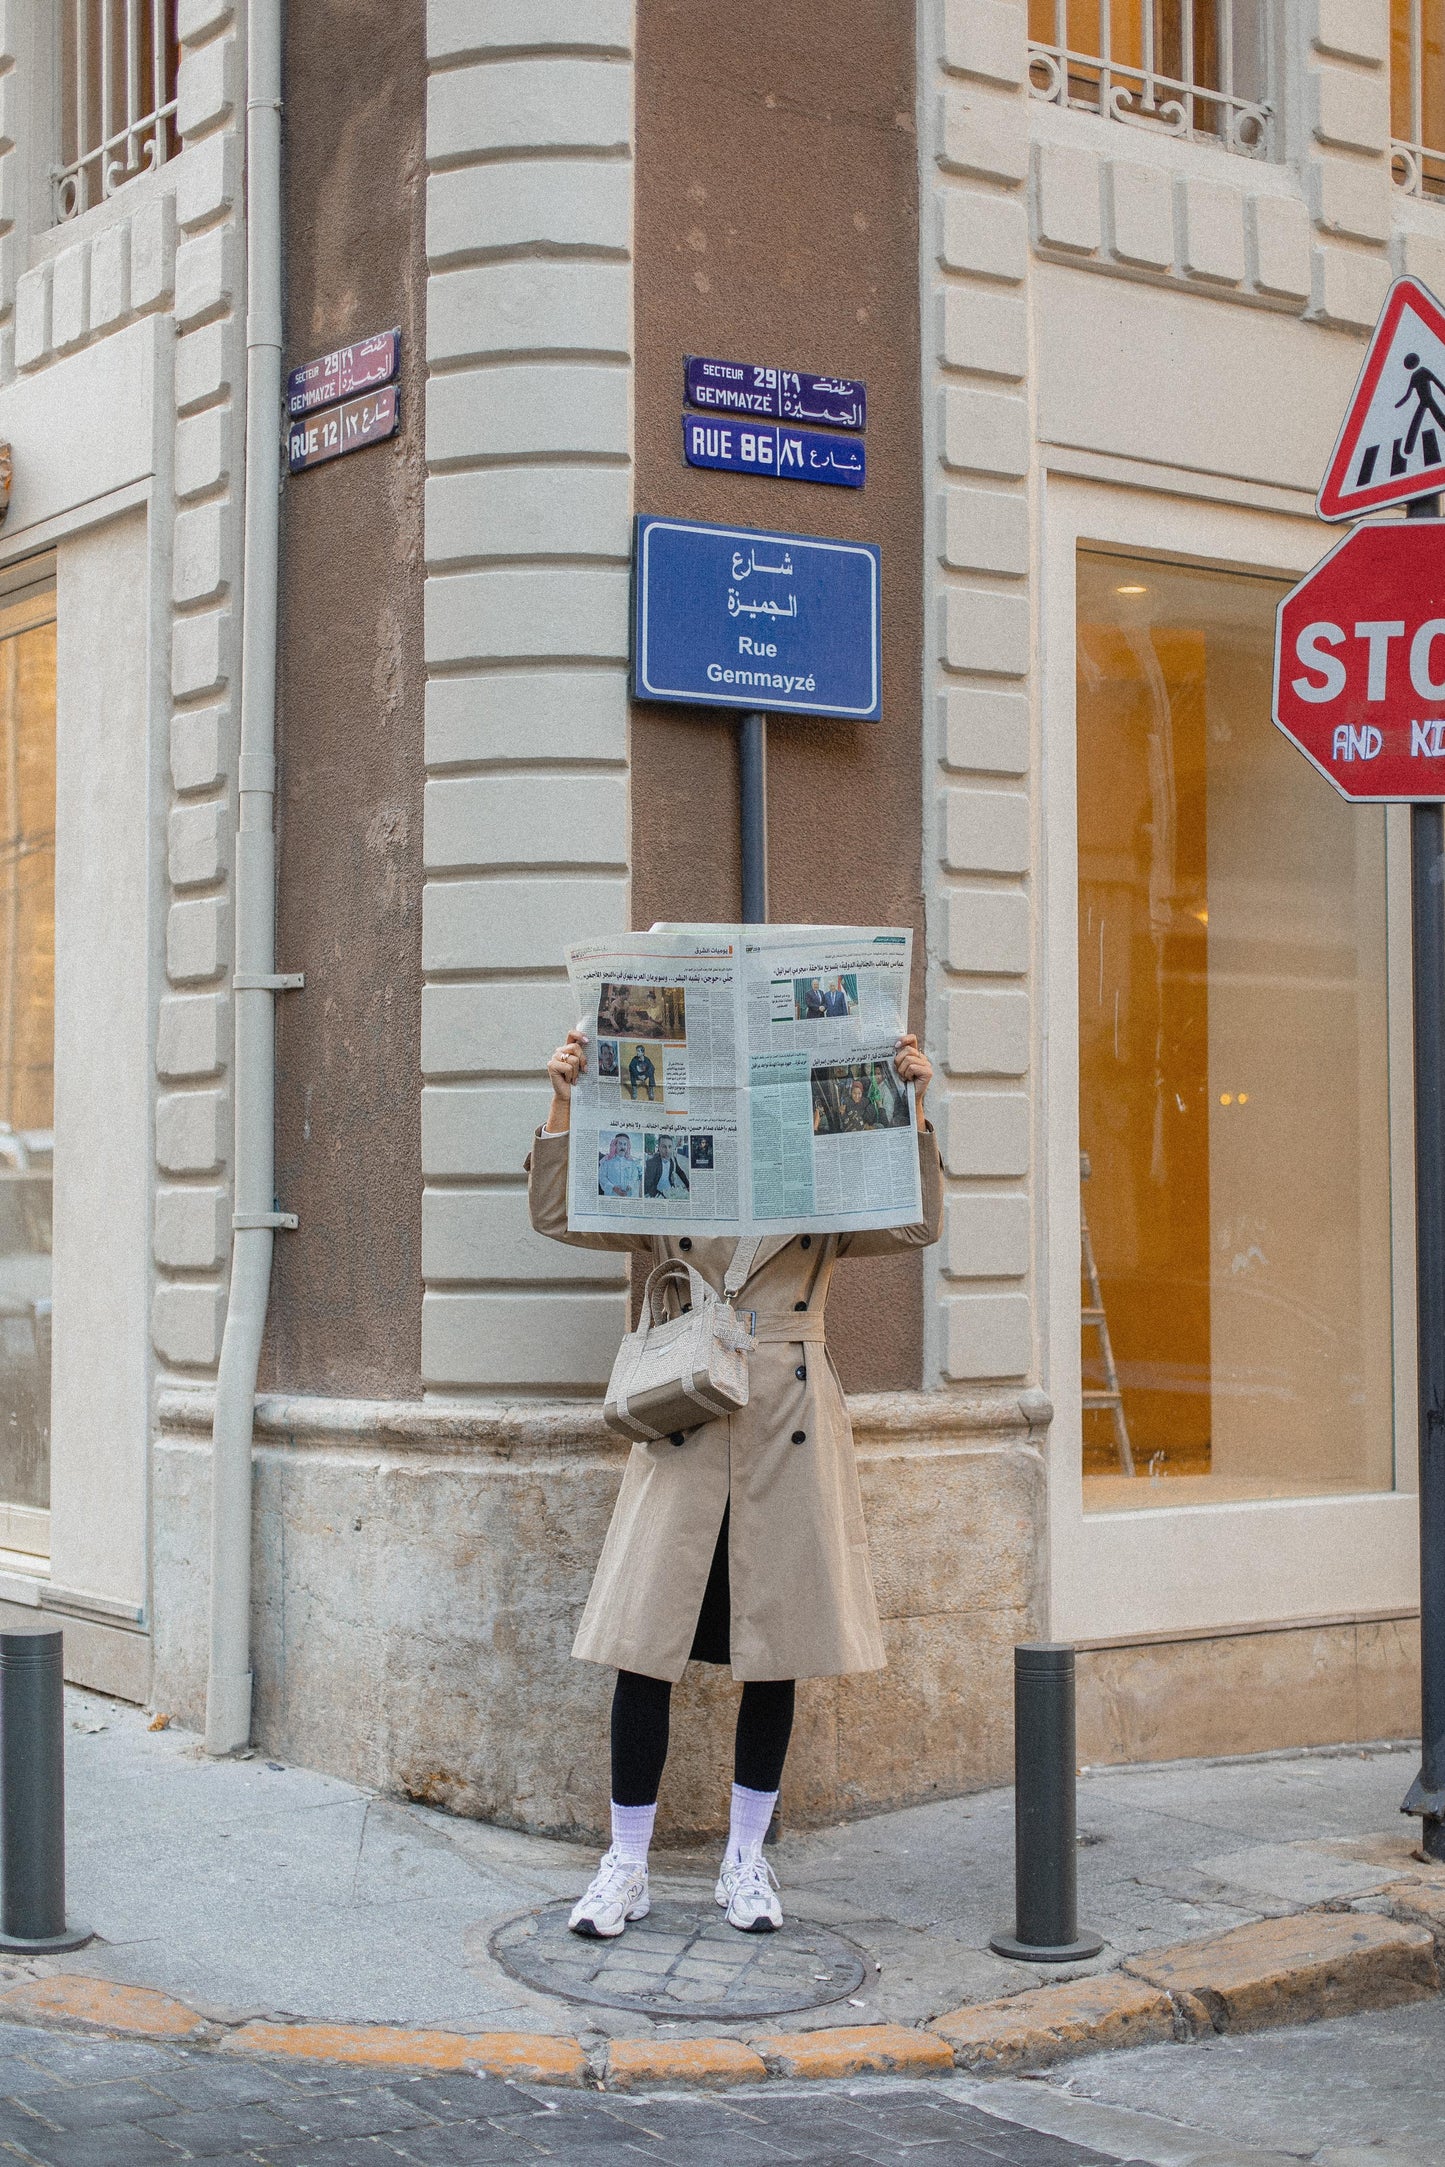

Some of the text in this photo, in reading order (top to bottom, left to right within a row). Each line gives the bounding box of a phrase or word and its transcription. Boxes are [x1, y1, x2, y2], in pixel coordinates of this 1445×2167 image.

[295, 354, 339, 384] SECTEUR 29
[703, 364, 777, 389] SECTEUR 29
[783, 372, 801, 393] ٢٩
[345, 399, 390, 439] شارع ١٢
[783, 393, 863, 426] الجميزة
[290, 421, 338, 460] RUE 12
[692, 427, 773, 464] RUE 86
[780, 438, 862, 471] شارع ٨٦
[731, 548, 793, 581] شارع
[727, 587, 797, 621] الجميزة
[738, 636, 778, 658] Rue
[706, 663, 816, 693] Gemmayzé
[1332, 723, 1384, 762] AND
[694, 946, 728, 955] يوميات الشرق
